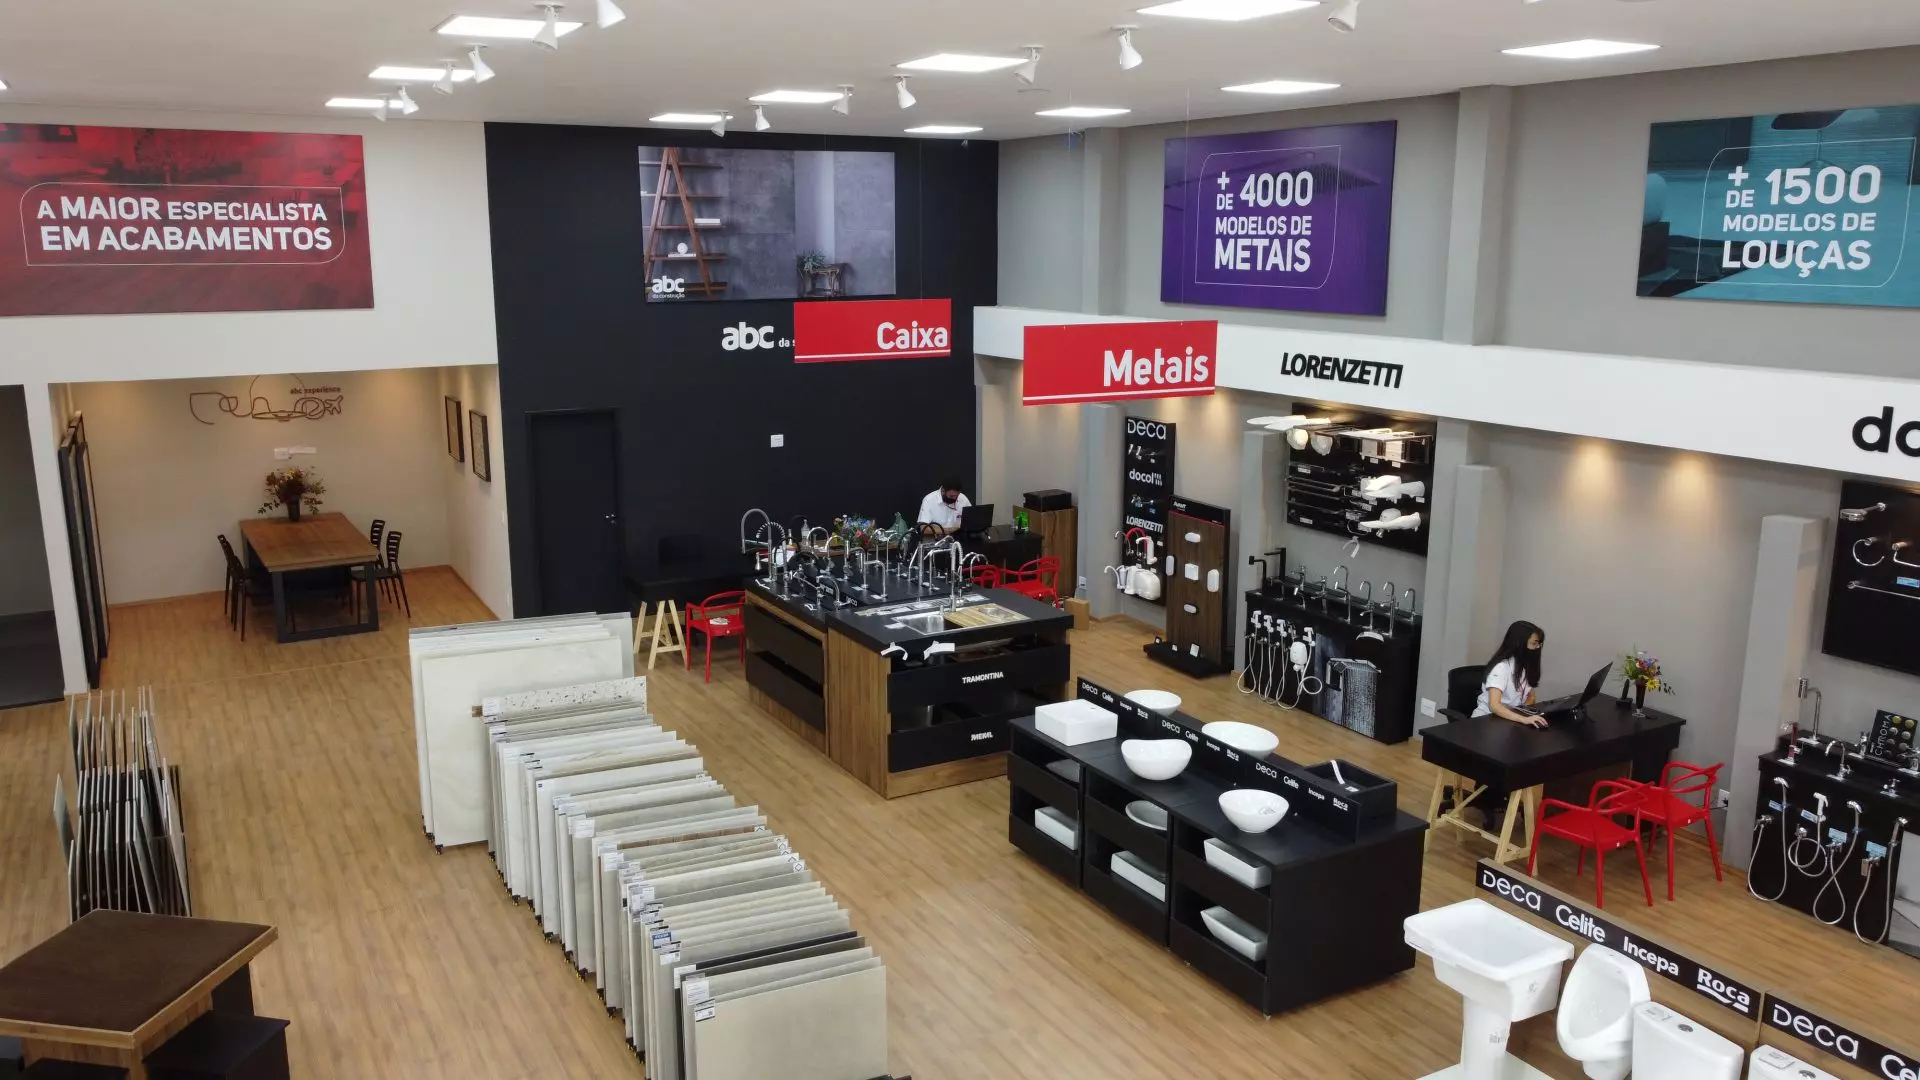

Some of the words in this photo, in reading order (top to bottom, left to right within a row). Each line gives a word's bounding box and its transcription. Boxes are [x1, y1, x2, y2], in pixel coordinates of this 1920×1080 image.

[1239, 171, 1314, 208] 4000
[1765, 164, 1881, 206] 1500
[37, 201, 56, 220] A
[60, 196, 162, 220] MAIOR
[168, 201, 328, 221] ESPECIALISTA
[1217, 193, 1234, 210] DE
[1725, 189, 1755, 208] DE
[1215, 215, 1286, 236] MODELOS
[1291, 215, 1312, 236] DE
[1722, 213, 1837, 233] MODELOS
[1842, 212, 1877, 232] DE
[41, 226, 91, 251] EM
[98, 226, 333, 251] ACABAMENTOS
[1214, 238, 1312, 273] METAIS
[1722, 239, 1872, 278] LOUÇAS
[651, 275, 685, 293] abc
[721, 322, 774, 351] abc
[778, 338, 790, 348] da
[876, 321, 948, 351] Caixa
[1103, 346, 1209, 388] Metais
[1281, 352, 1403, 389] LORENZETTI
[1127, 419, 1166, 440] Deca
[1129, 468, 1154, 484] docol
[1126, 515, 1163, 533] LORENZETTI
[962, 671, 1004, 685] TRAMONTINA
[1255, 762, 1277, 778] Deca
[1482, 869, 1541, 912] Deca
[1555, 904, 1606, 943] Celite
[1622, 935, 1680, 977] Incepa
[1698, 967, 1750, 1005] Roca
[1772, 1003, 1860, 1060] Deca
